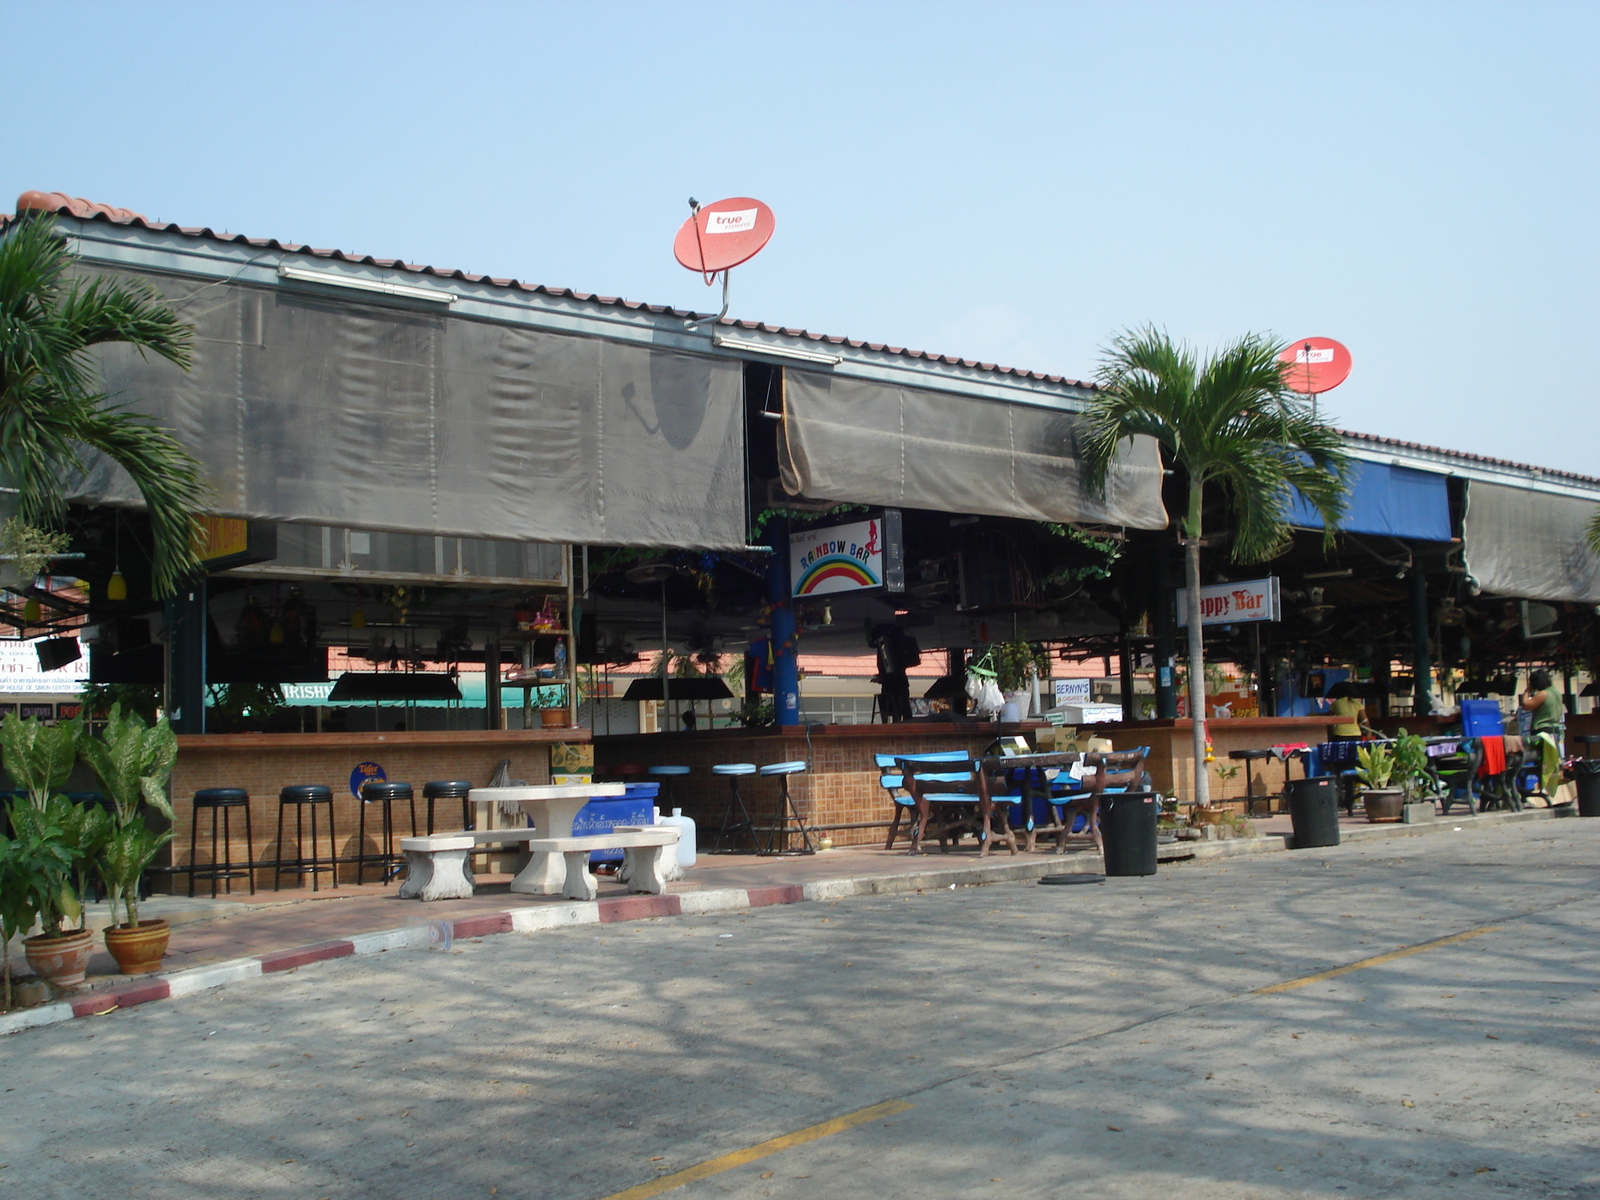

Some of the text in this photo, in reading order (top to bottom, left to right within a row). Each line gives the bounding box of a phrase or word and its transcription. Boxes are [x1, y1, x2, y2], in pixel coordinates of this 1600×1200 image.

[716, 216, 742, 224] true
[801, 541, 846, 569] RAINBOW
[850, 543, 870, 564] BAR
[1200, 590, 1263, 617] appy Bar
[22, 707, 51, 718] HOUSE
[359, 764, 378, 776] Tiger
